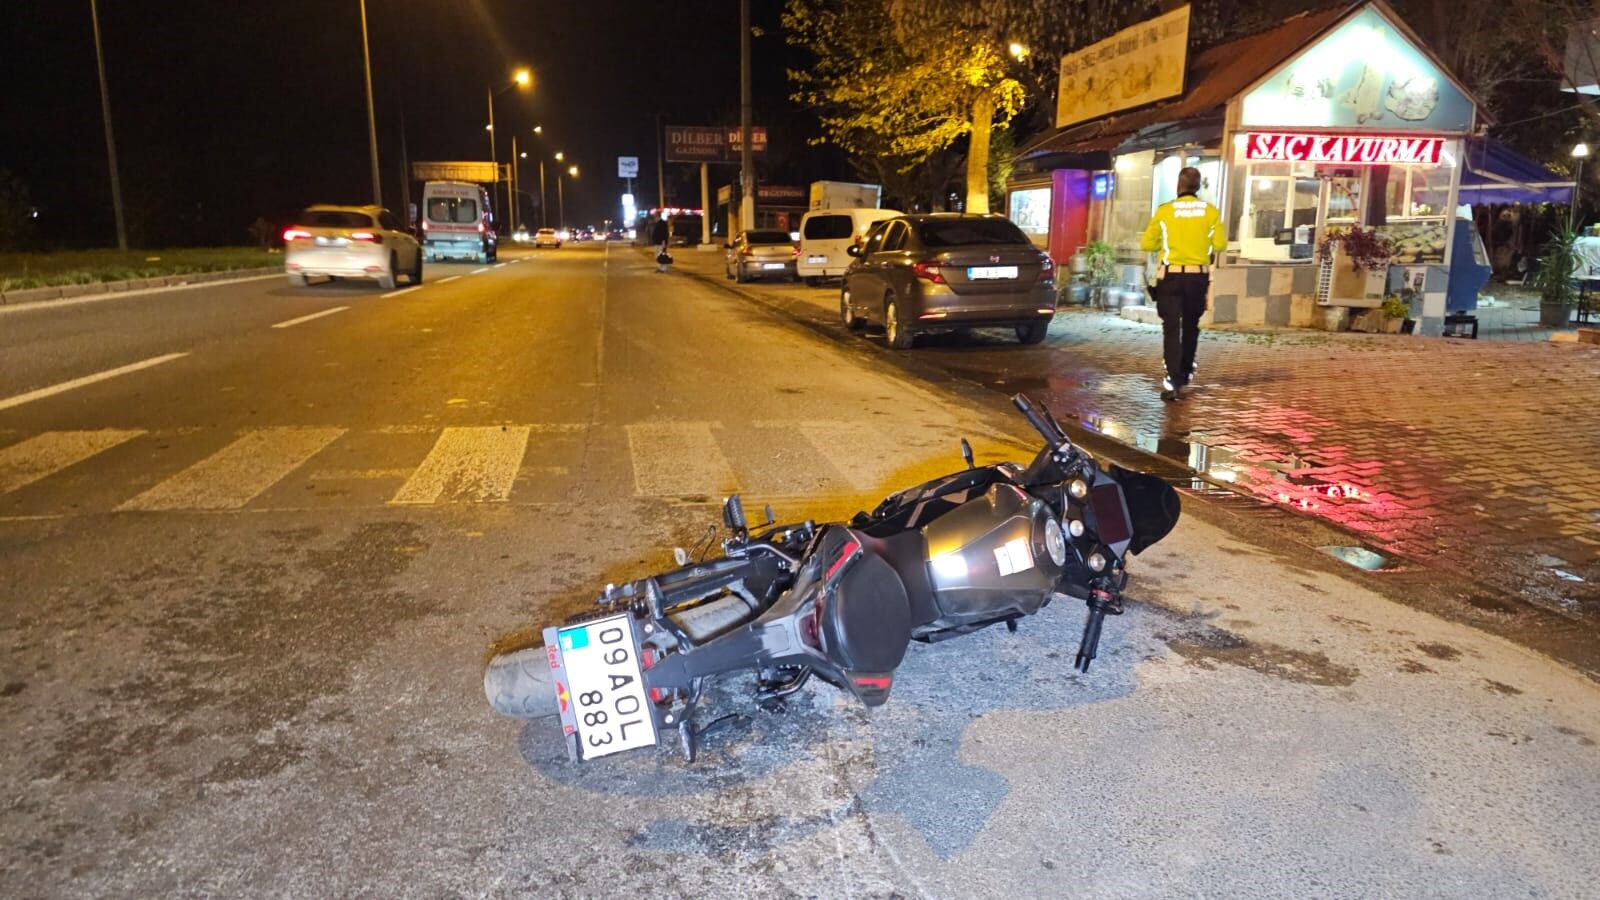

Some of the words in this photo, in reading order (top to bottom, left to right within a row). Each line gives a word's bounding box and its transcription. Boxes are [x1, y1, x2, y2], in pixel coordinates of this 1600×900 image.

[1306, 137, 1434, 163] KAVURMA
[547, 645, 560, 669] Red
[579, 690, 613, 747] 883
[608, 674, 643, 740] AOL
